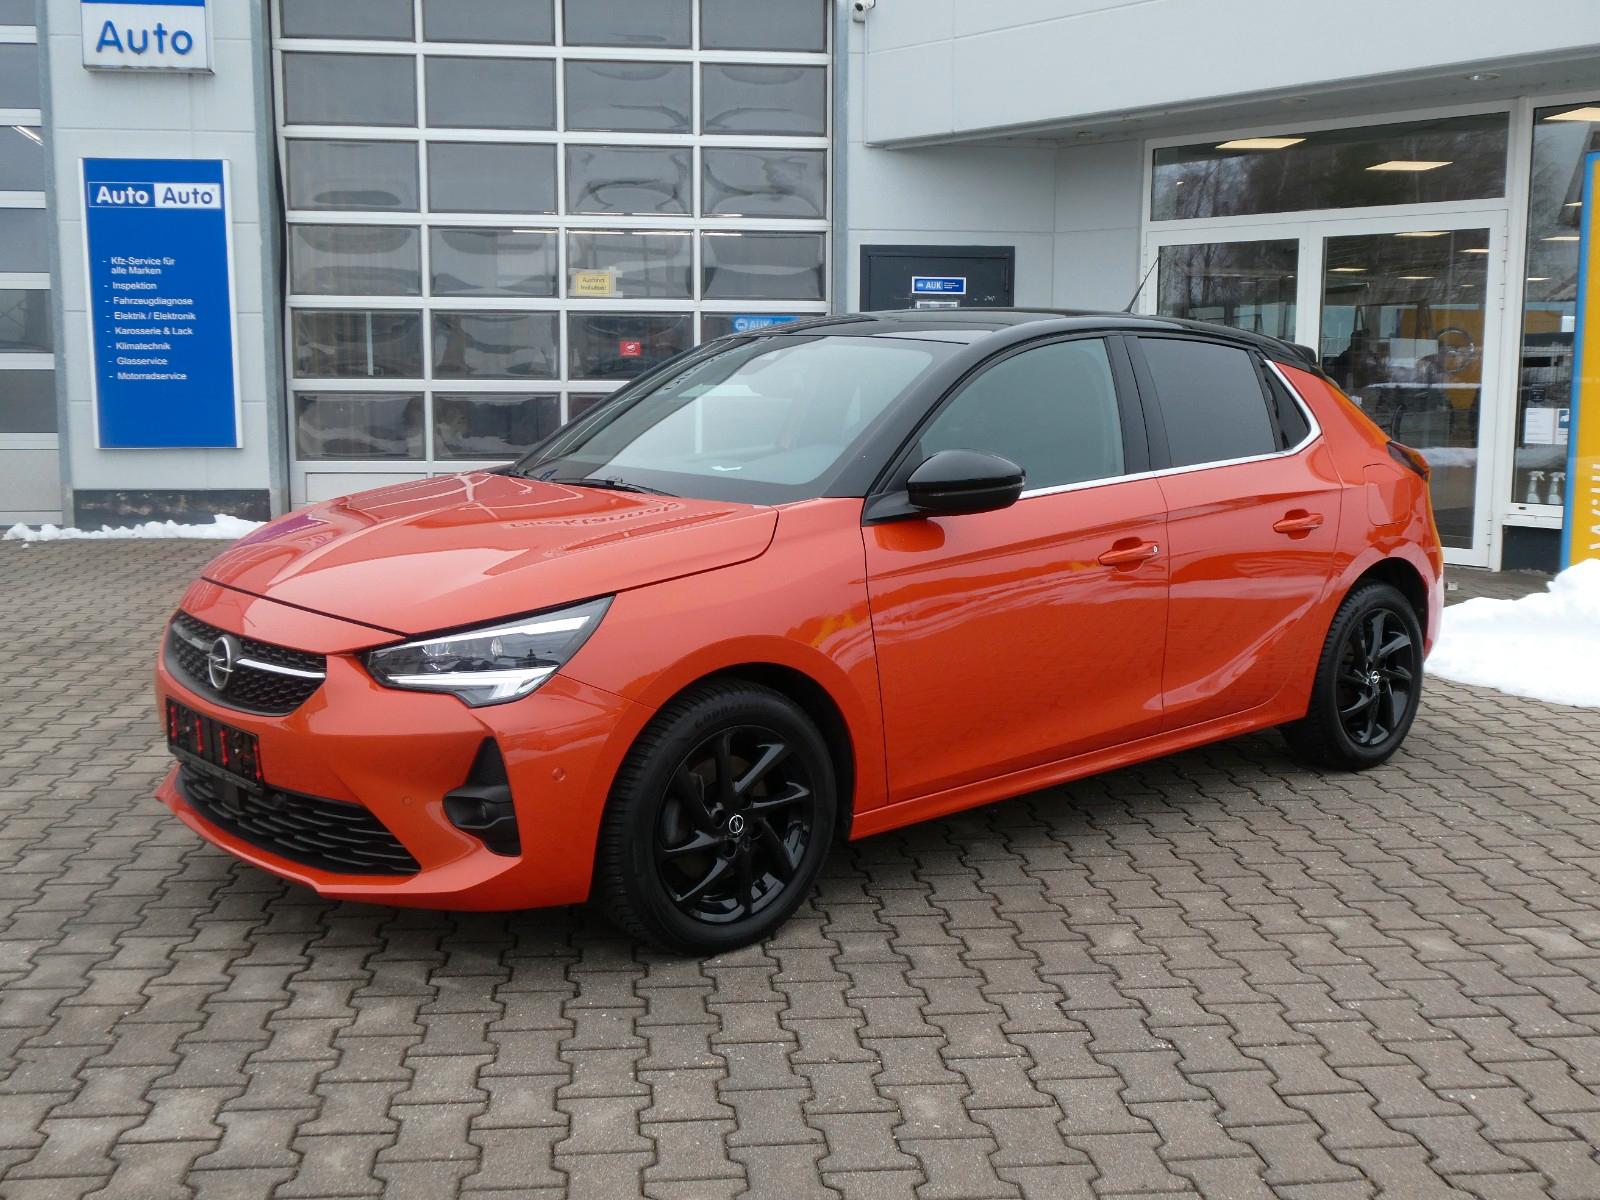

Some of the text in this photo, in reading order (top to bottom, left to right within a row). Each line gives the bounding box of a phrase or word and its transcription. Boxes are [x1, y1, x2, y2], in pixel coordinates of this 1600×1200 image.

[95, 20, 193, 55] Auto
[96, 186, 213, 204] Auto Auto
[111, 256, 175, 265] Kfz-Service für
[111, 267, 162, 275] alle Marken
[112, 281, 157, 291] Inspektion
[925, 281, 942, 289] AUK
[113, 296, 193, 306] Fahrzeugdiagnose
[114, 311, 147, 320] Elektrik
[153, 311, 196, 320] Elektronik
[114, 326, 193, 335] Karosserie & Lack
[115, 342, 171, 350] Klimatechnik
[116, 356, 168, 365] Glasservice
[117, 372, 187, 380] Motorradservice
